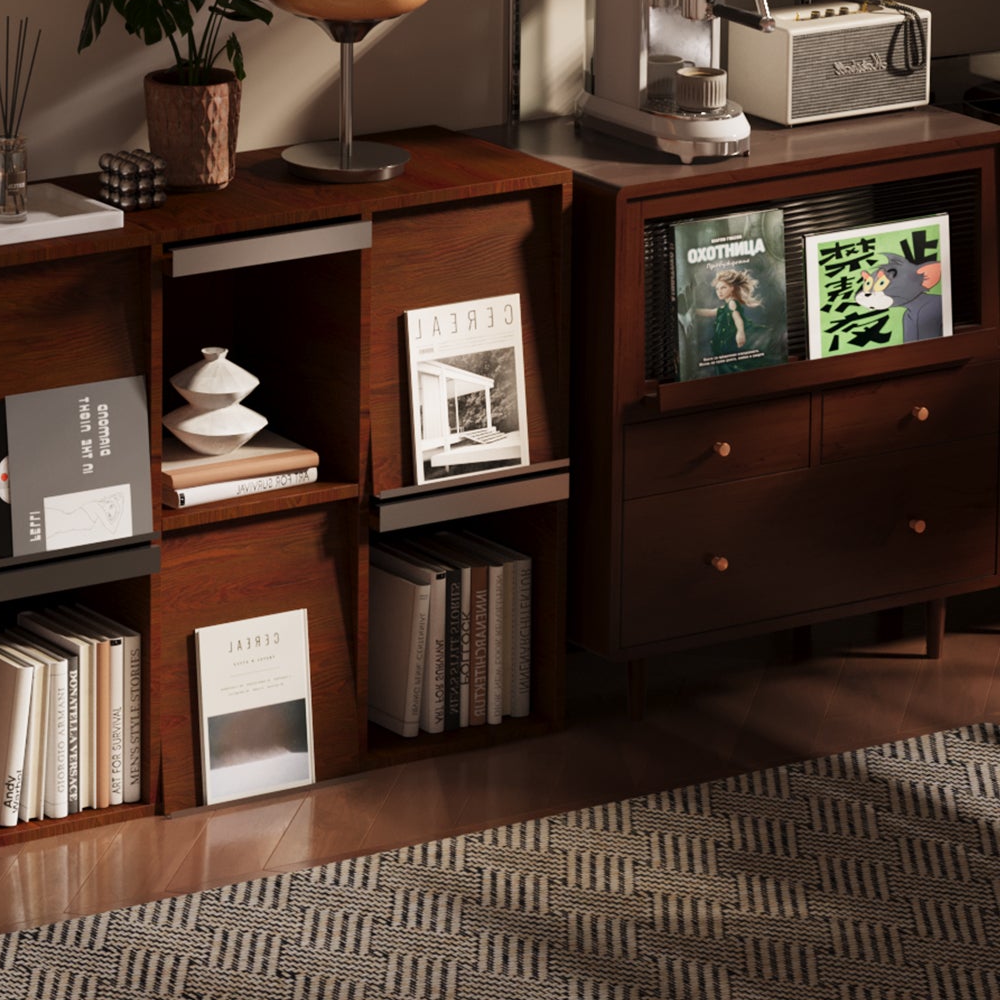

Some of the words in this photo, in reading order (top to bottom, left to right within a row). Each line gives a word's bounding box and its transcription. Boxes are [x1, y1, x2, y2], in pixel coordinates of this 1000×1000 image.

[687, 238, 766, 264] ОХОТНИЦА
[130, 648, 141, 703] STORIES
[56, 688, 66, 737] ARMANI
[68, 669, 78, 744] DONATELLA
[130, 706, 141, 745] STYLE
[111, 707, 122, 752] SURVIVAL
[56, 741, 66, 793] GIORGIO
[68, 745, 78, 803] VERSACE
[111, 754, 122, 775] FOR
[130, 748, 141, 786] MEN'S
[3, 775, 16, 809] Andy
[111, 777, 122, 795] ART
